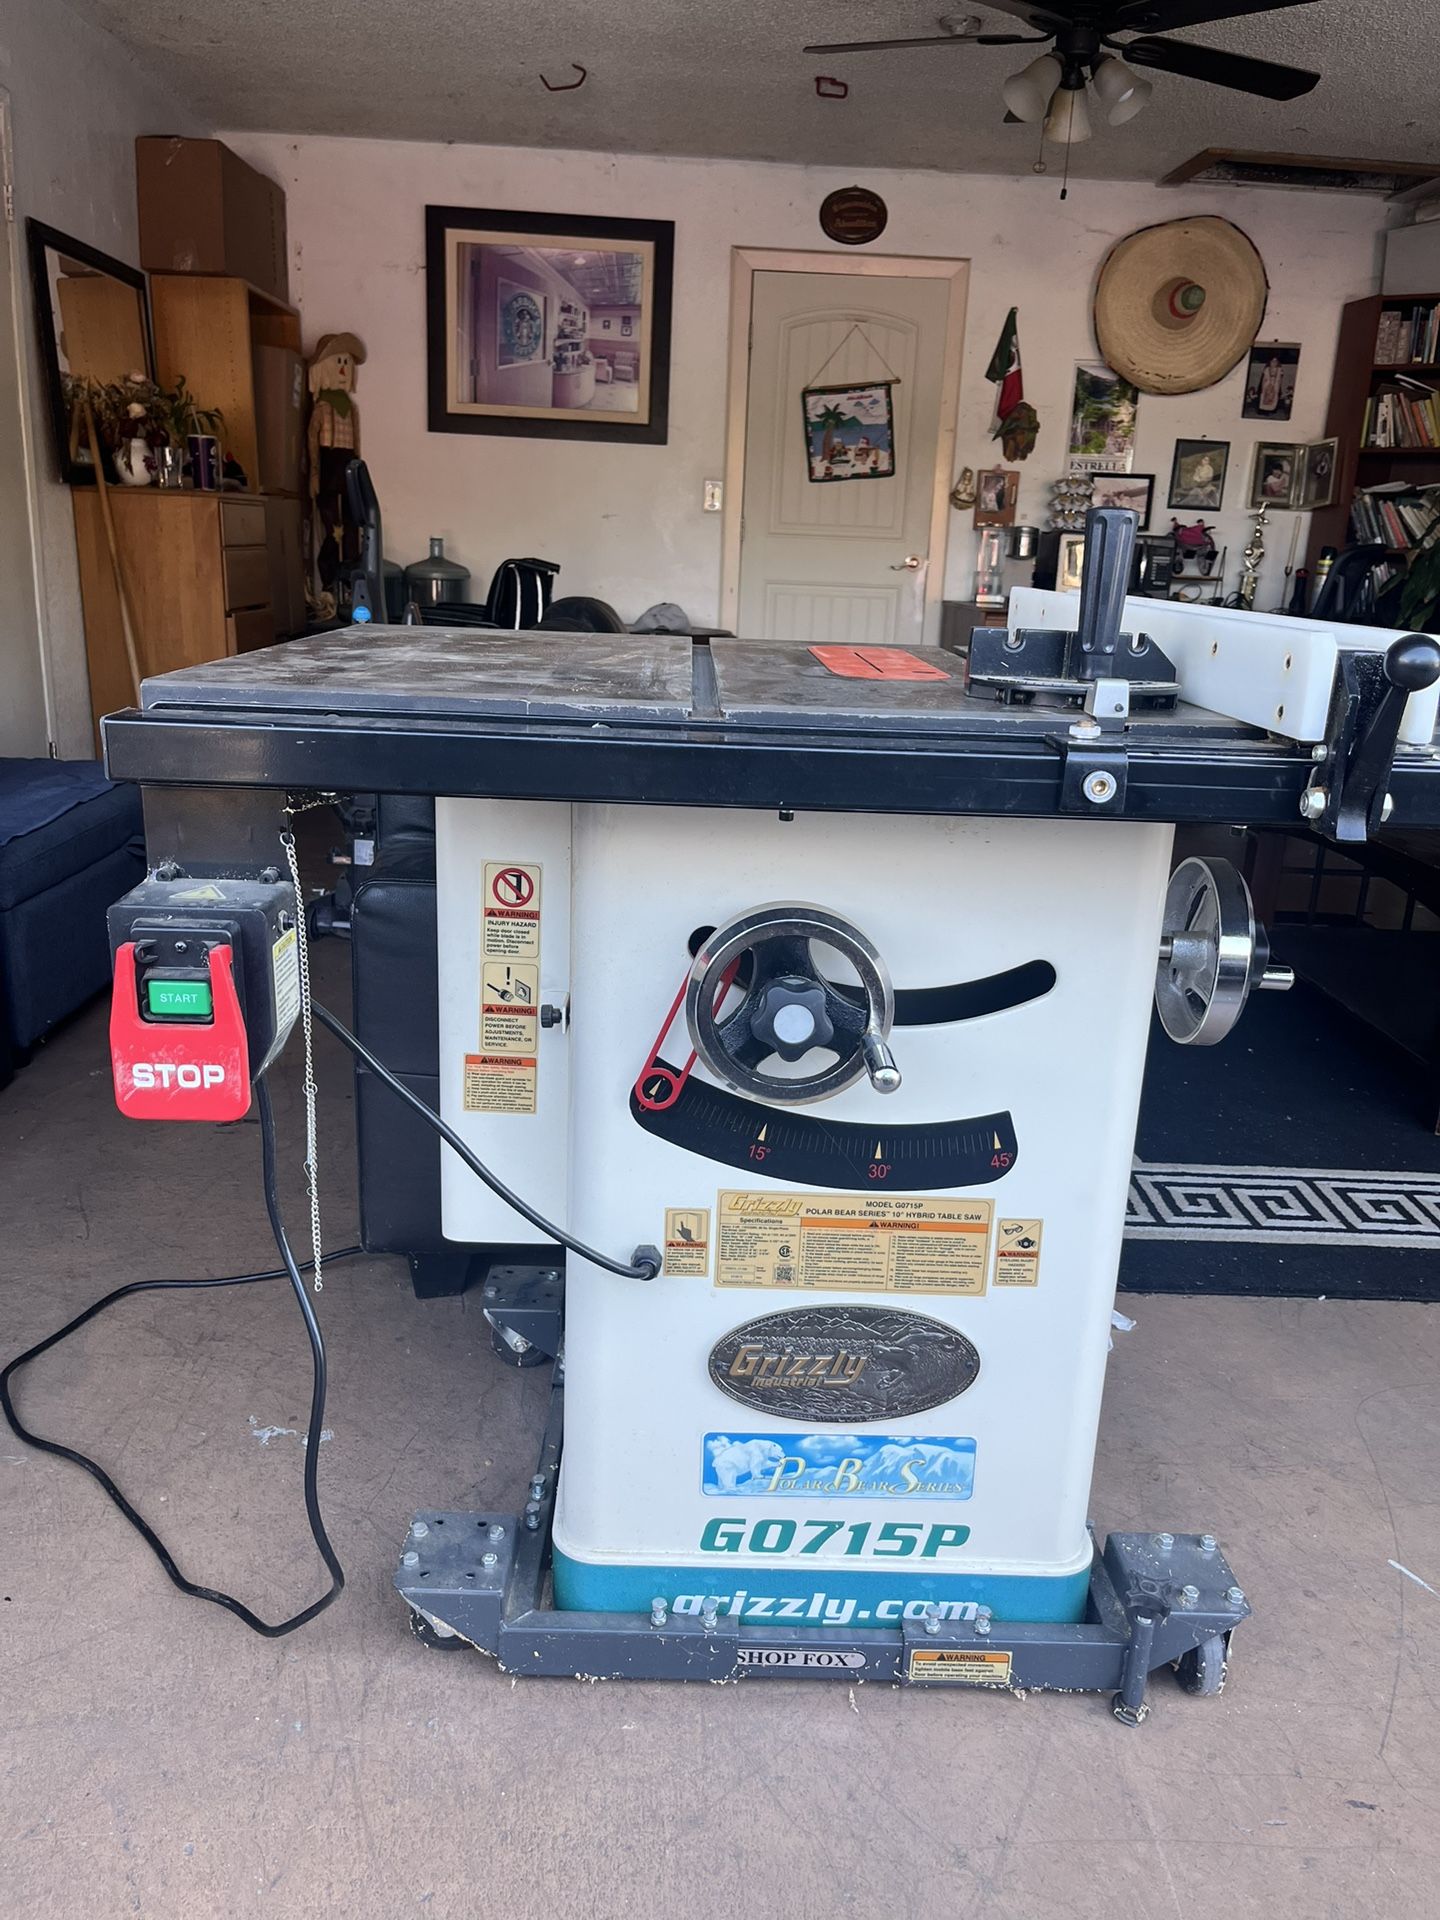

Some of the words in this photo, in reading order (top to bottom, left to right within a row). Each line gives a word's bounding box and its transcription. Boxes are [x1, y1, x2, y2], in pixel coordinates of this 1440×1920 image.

[160, 993, 198, 1003] START
[488, 1057, 522, 1066] WARNING
[132, 1062, 225, 1089] STOP
[740, 1217, 783, 1225] Specifications
[806, 1208, 833, 1216] POLAR
[963, 1213, 982, 1221] SAW
[729, 1344, 868, 1386] Grizzly
[700, 1517, 971, 1558] G0715P
[737, 1650, 796, 1665] SHOP
[946, 1654, 986, 1662] WARNING
